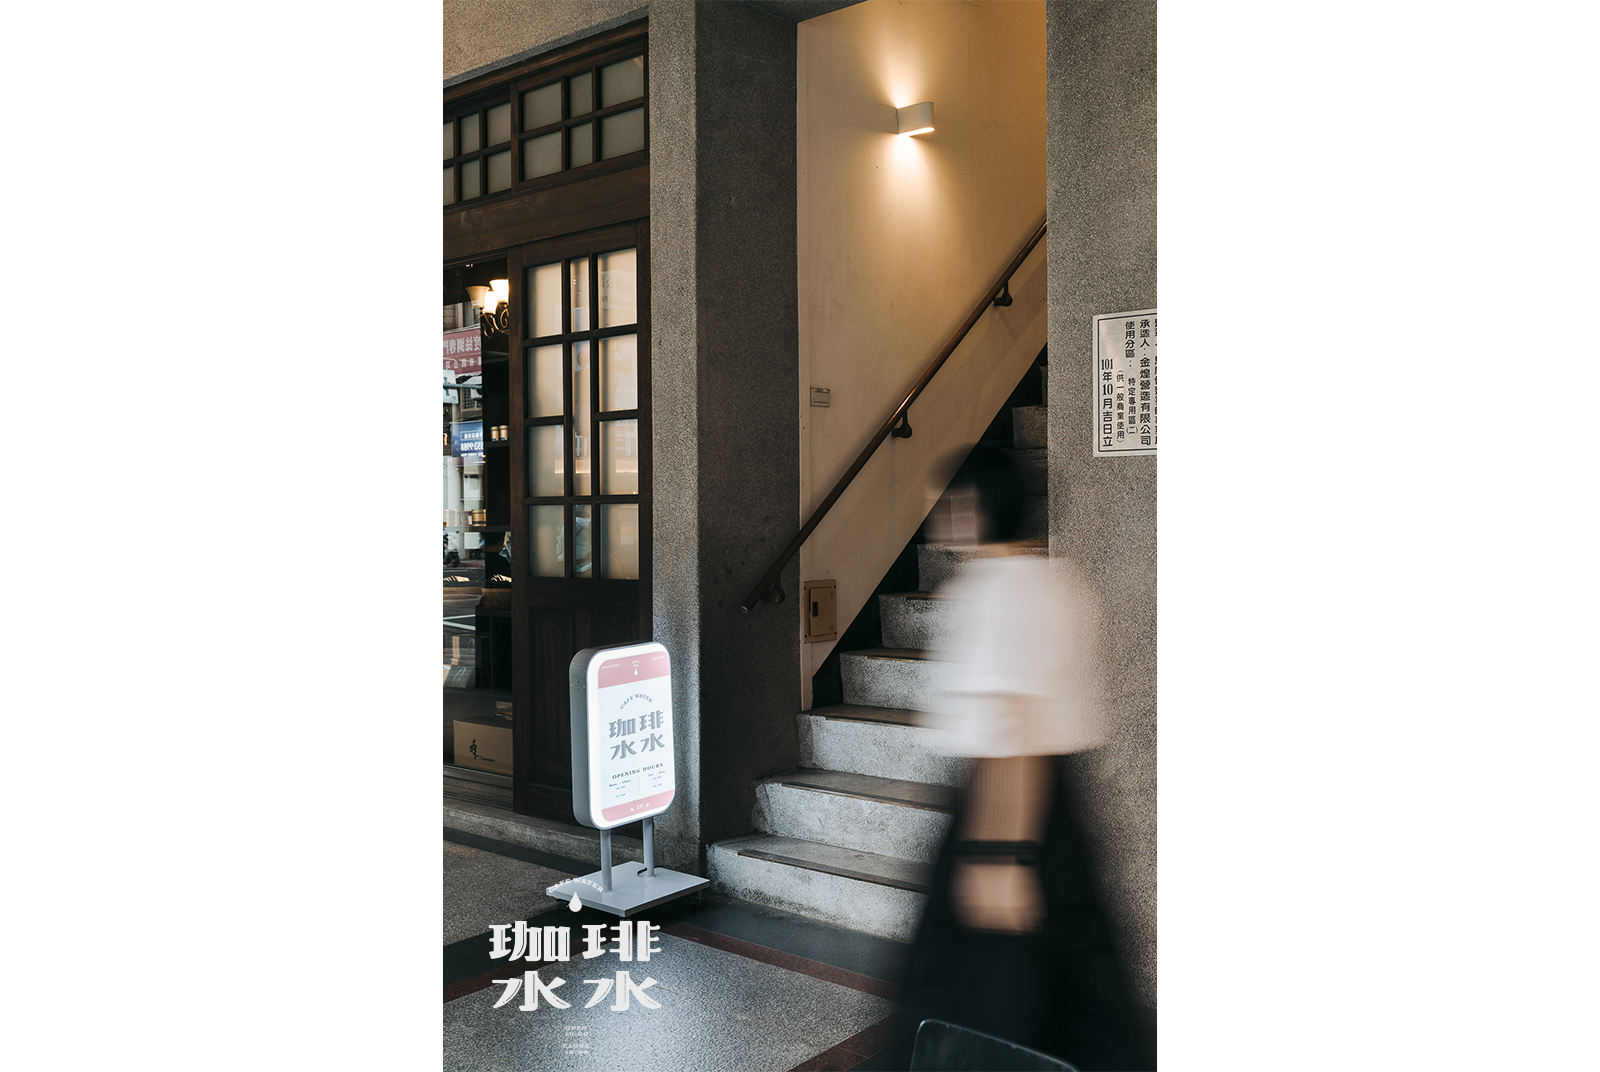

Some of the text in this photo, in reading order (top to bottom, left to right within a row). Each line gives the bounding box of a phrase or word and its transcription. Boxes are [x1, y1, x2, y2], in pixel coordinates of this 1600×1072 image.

[620, 693, 653, 710] CAFE WATER
[608, 709, 664, 738] 珈琲
[610, 732, 666, 760] 水水
[612, 762, 664, 780] OPENING HOURS
